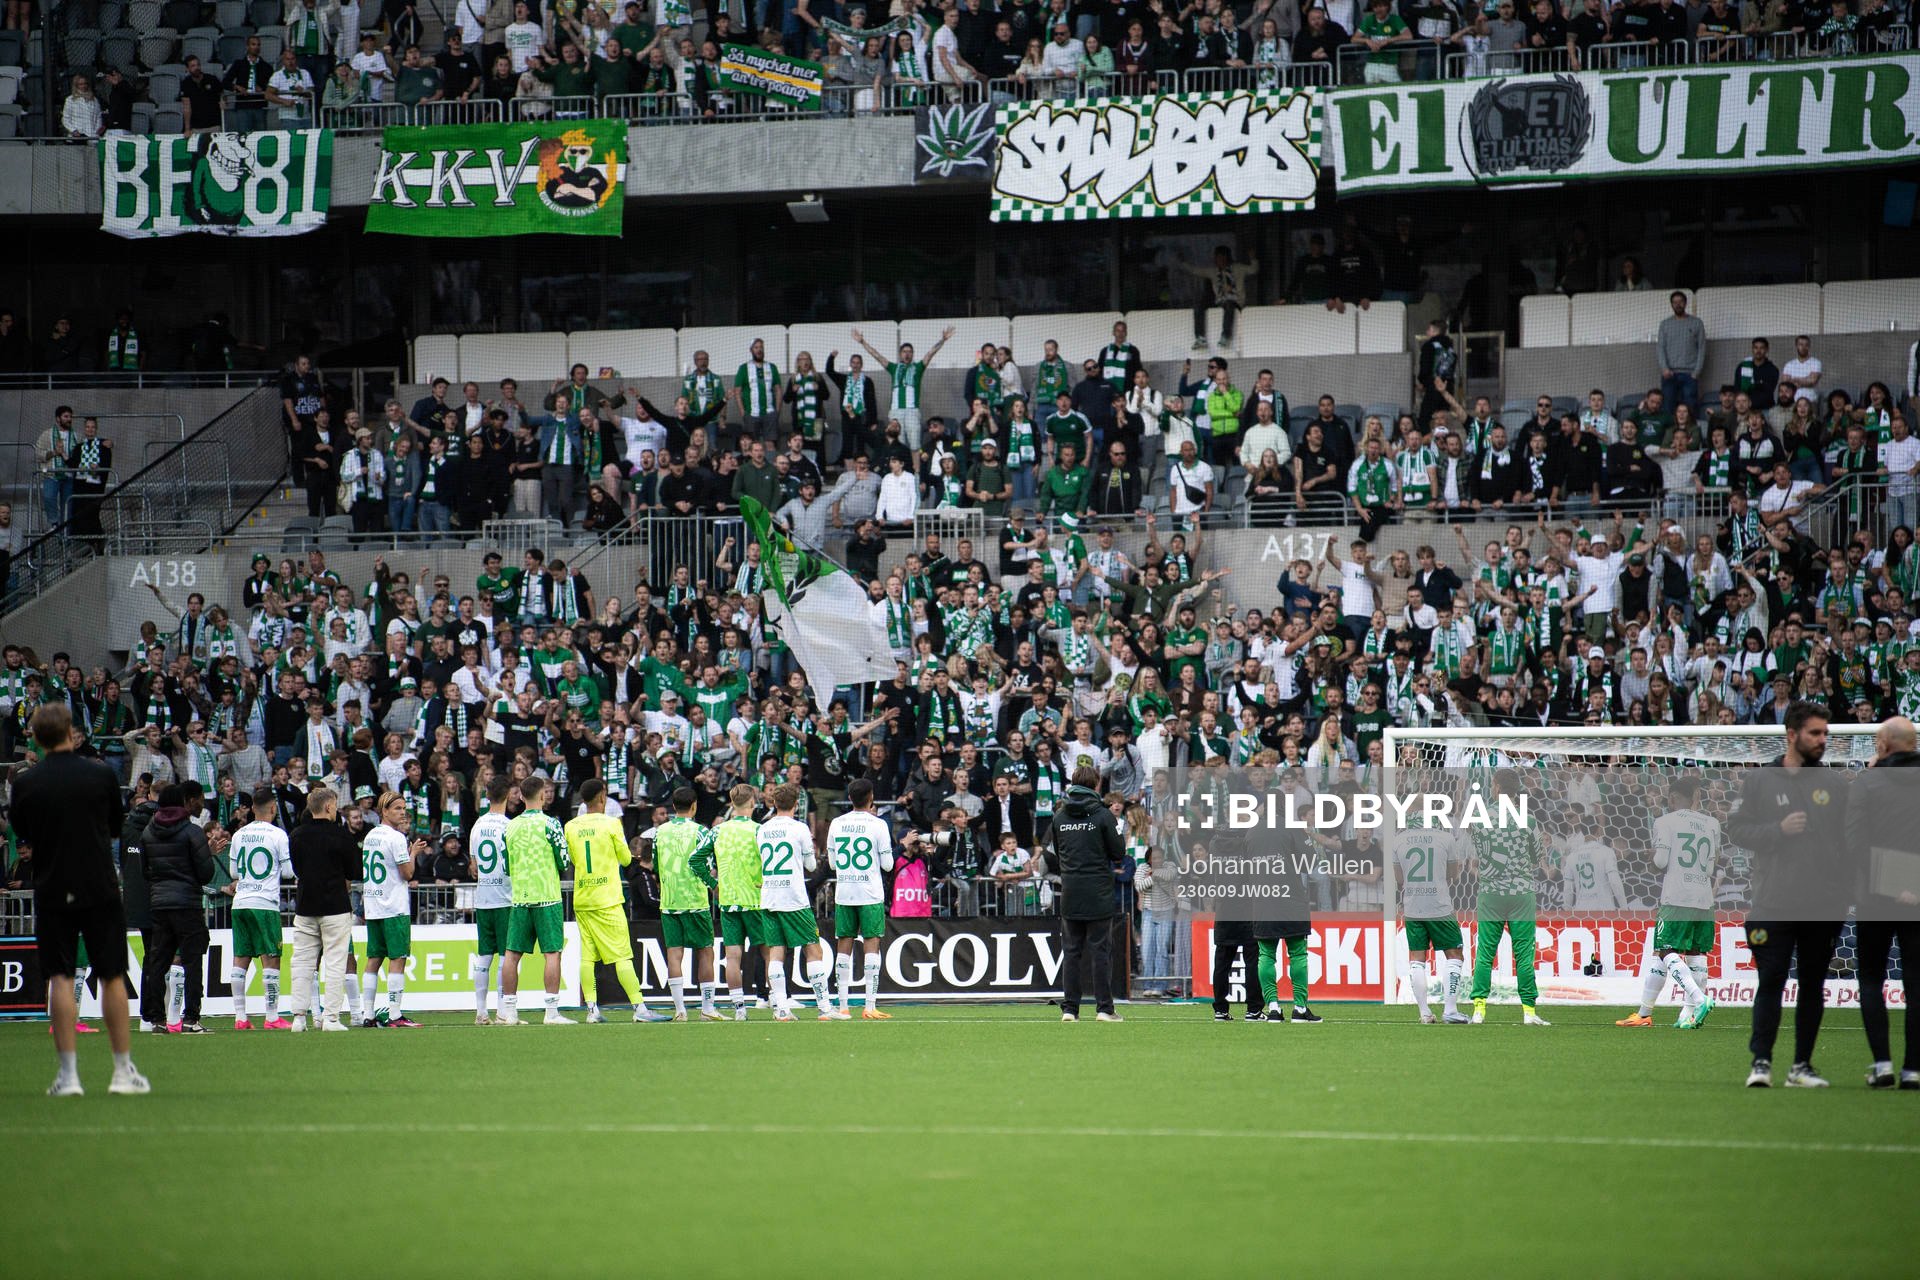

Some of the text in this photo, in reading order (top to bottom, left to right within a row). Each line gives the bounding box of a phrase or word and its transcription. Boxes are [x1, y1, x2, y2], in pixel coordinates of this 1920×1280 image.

[727, 47, 818, 79] Så mycket mer
[731, 69, 748, 84] än
[751, 73, 766, 88] tre
[1603, 63, 1920, 164] ULTR
[1151, 93, 1318, 207] BOYS
[1502, 137, 1571, 156] ULTRAS
[1529, 155, 1571, 171] 2023
[1261, 533, 1332, 562] A137
[130, 560, 196, 588] A138
[1059, 823, 1088, 832] CRAFT
[1406, 836, 1433, 845] STRAND
[127, 846, 141, 854] CRA
[236, 846, 273, 880] 40
[478, 839, 498, 874] 9
[585, 841, 592, 874] 1
[760, 841, 794, 876] 22
[835, 837, 873, 871] 38
[1405, 847, 1434, 883] 21
[1677, 832, 1711, 873] 30
[362, 850, 387, 885] 36
